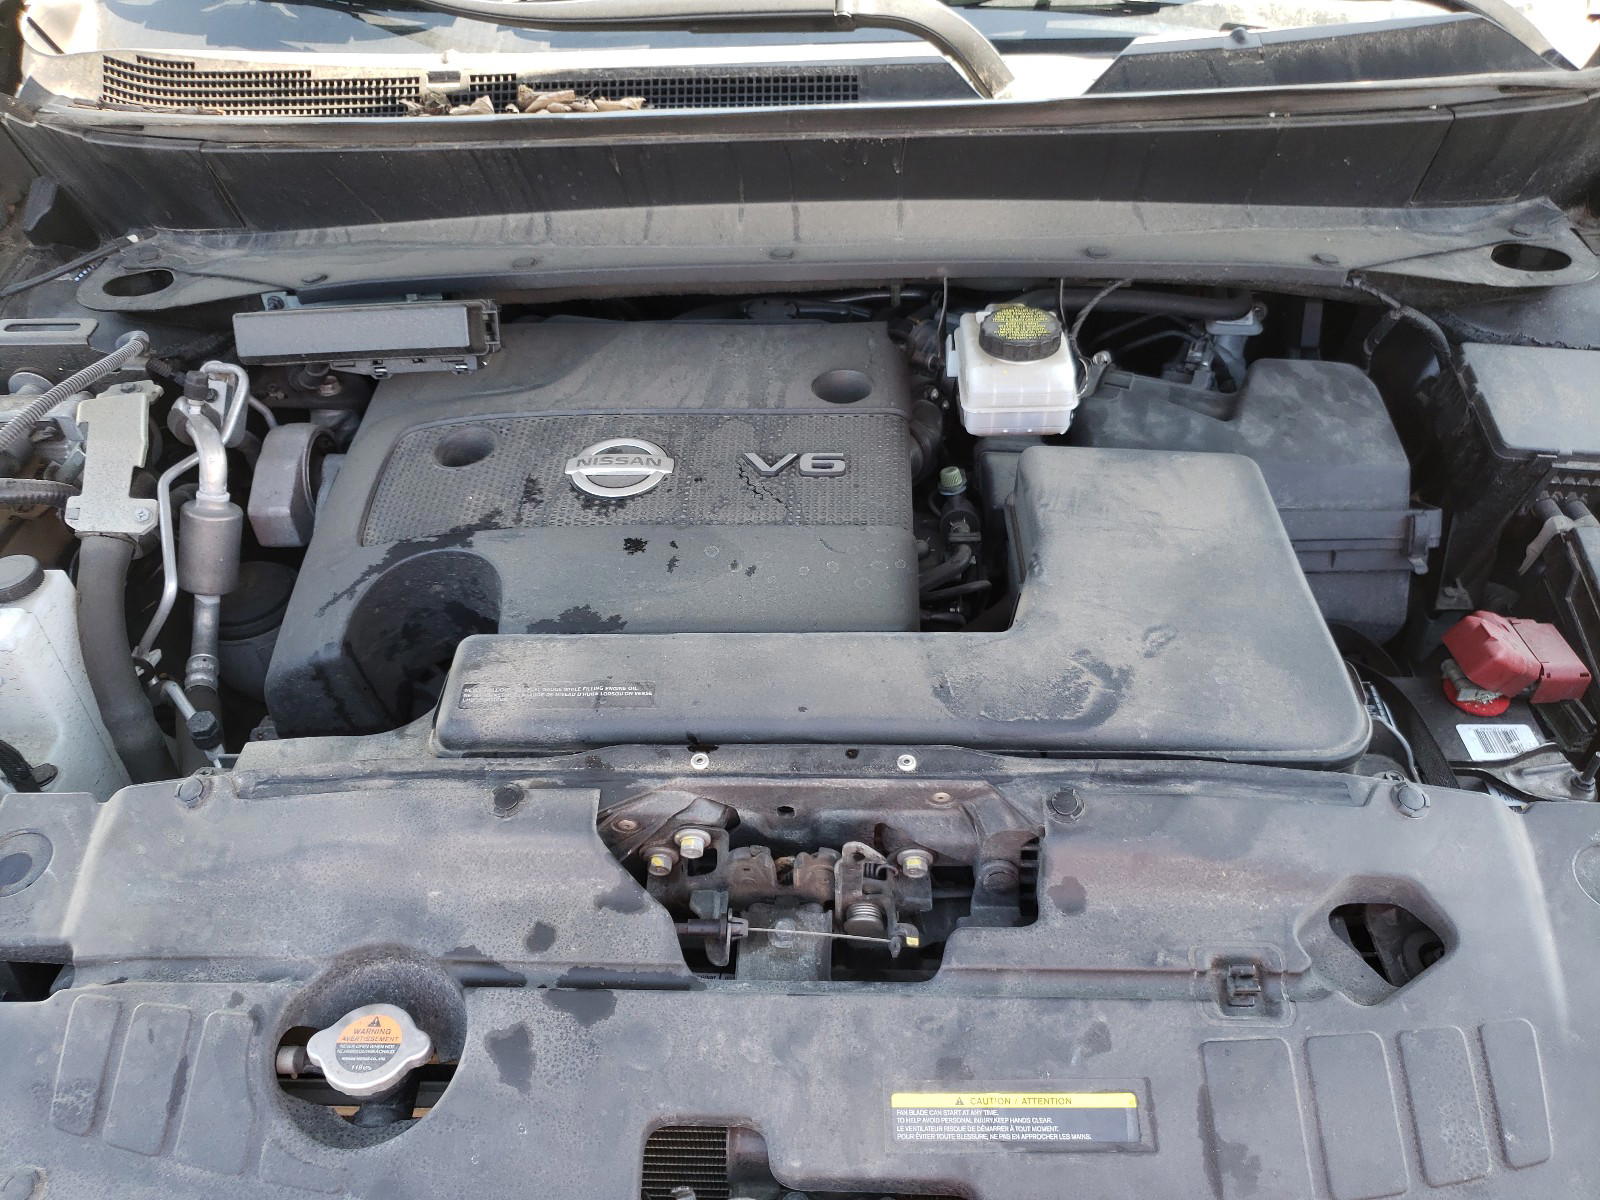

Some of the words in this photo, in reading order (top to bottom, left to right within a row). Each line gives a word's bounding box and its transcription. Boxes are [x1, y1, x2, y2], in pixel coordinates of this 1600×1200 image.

[575, 456, 662, 467] NISSAN
[744, 452, 846, 478] V6
[970, 1097, 1011, 1105] CAUTION
[1021, 1097, 1072, 1105] ATTENTION
